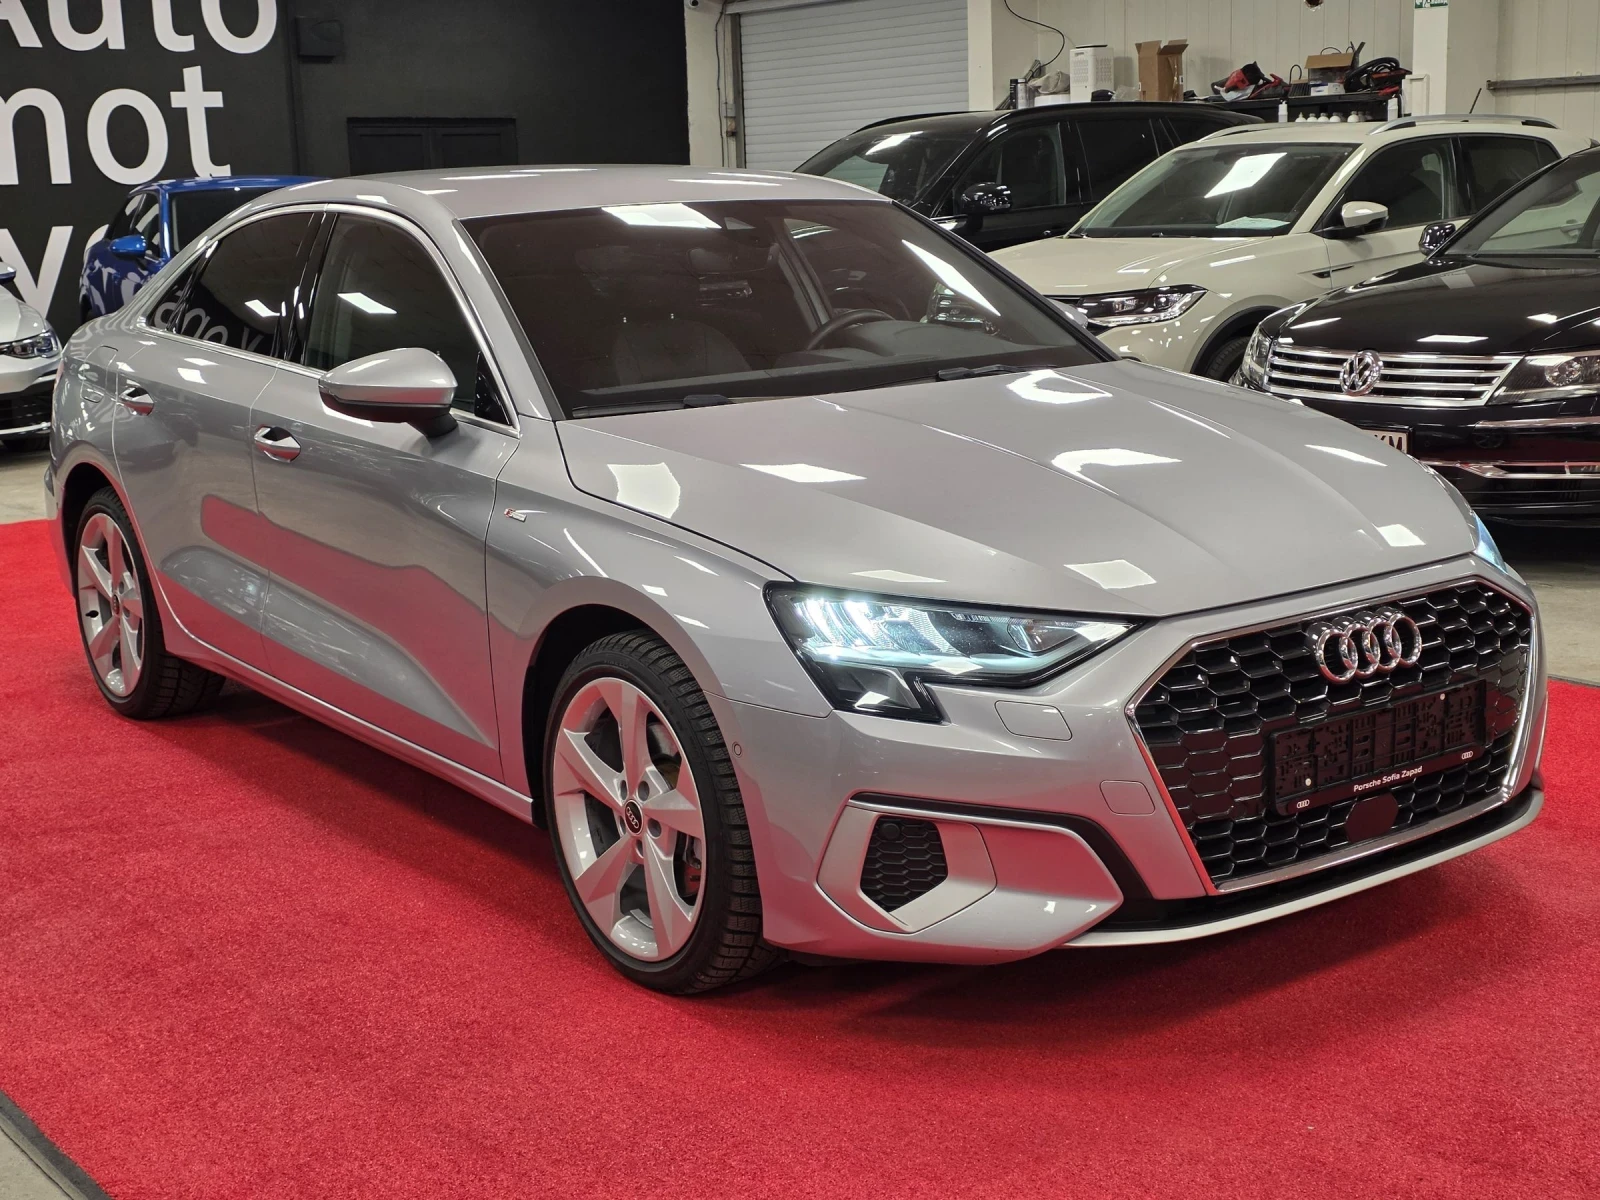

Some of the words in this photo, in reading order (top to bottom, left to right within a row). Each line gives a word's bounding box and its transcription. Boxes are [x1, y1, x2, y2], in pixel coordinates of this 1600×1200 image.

[1353, 779, 1381, 792] Porsche
[1382, 773, 1400, 784] Sofia
[1401, 765, 1423, 778] Zapad
